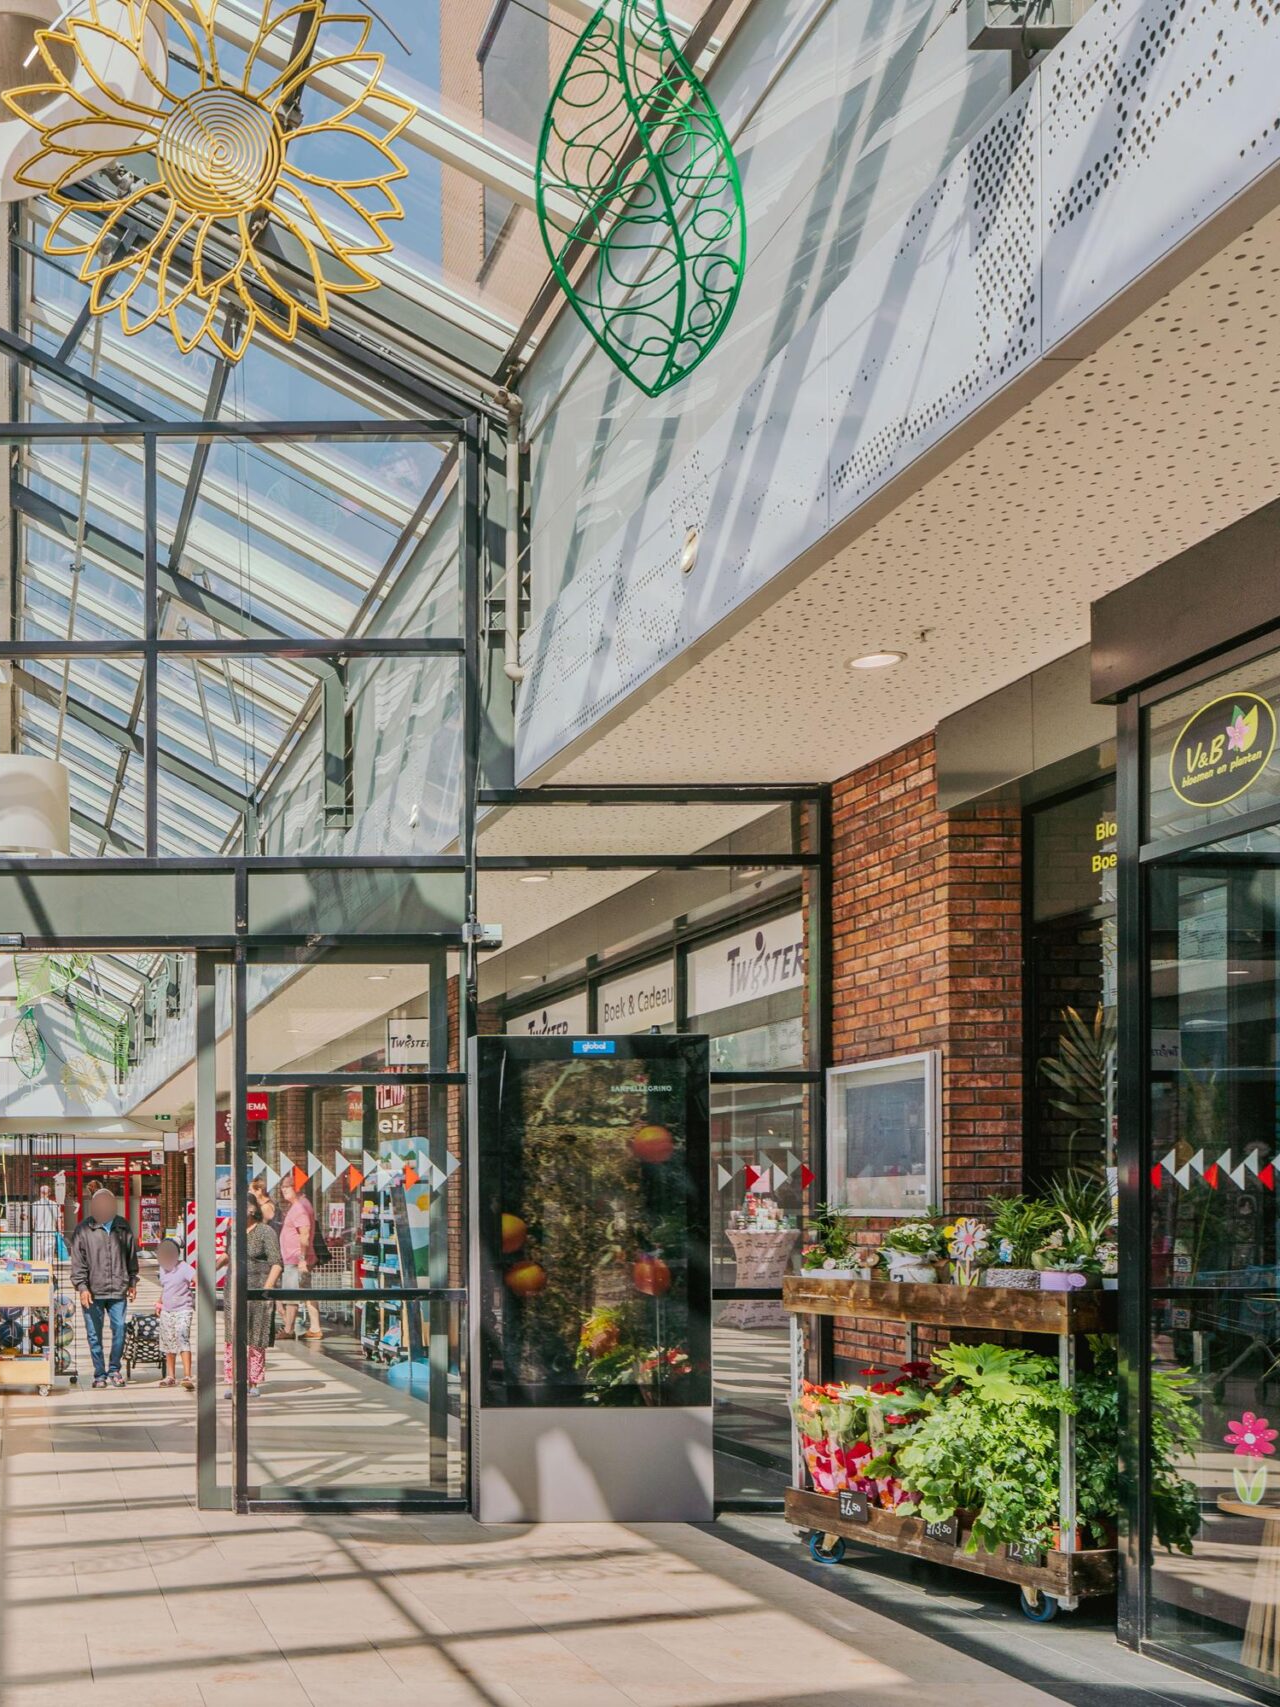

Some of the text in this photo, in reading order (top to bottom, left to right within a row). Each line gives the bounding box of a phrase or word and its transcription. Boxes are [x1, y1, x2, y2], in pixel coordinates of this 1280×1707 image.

[1181, 750, 1263, 789] bloemen en planten
[1186, 734, 1225, 773] V&B
[603, 1000, 626, 1024] Boek
[628, 995, 636, 1014] &
[582, 1041, 607, 1052] global
